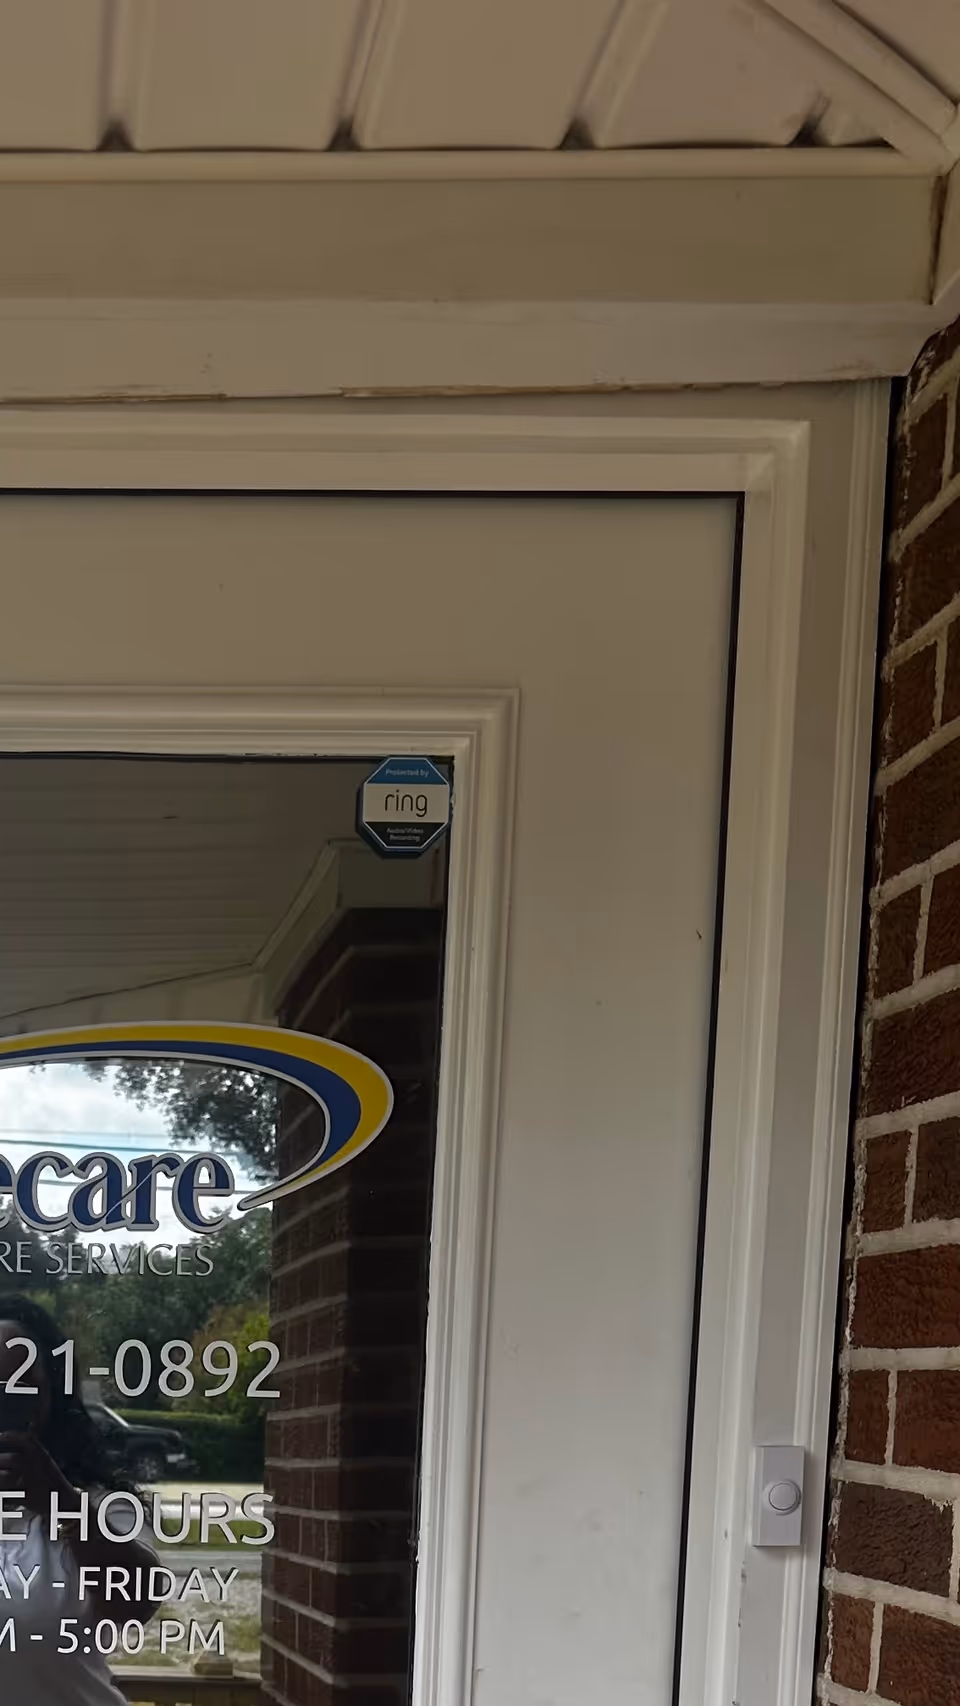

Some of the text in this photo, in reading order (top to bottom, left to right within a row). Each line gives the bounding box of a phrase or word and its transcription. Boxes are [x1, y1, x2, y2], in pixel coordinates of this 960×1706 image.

[385, 789, 427, 818] ring
[45, 1242, 214, 1278] SERVICES
[49, 1490, 277, 1546] HOURS
[78, 1566, 240, 1603] FRIDAY
[57, 1619, 145, 1655] 5:00
[160, 1621, 226, 1656] PM
